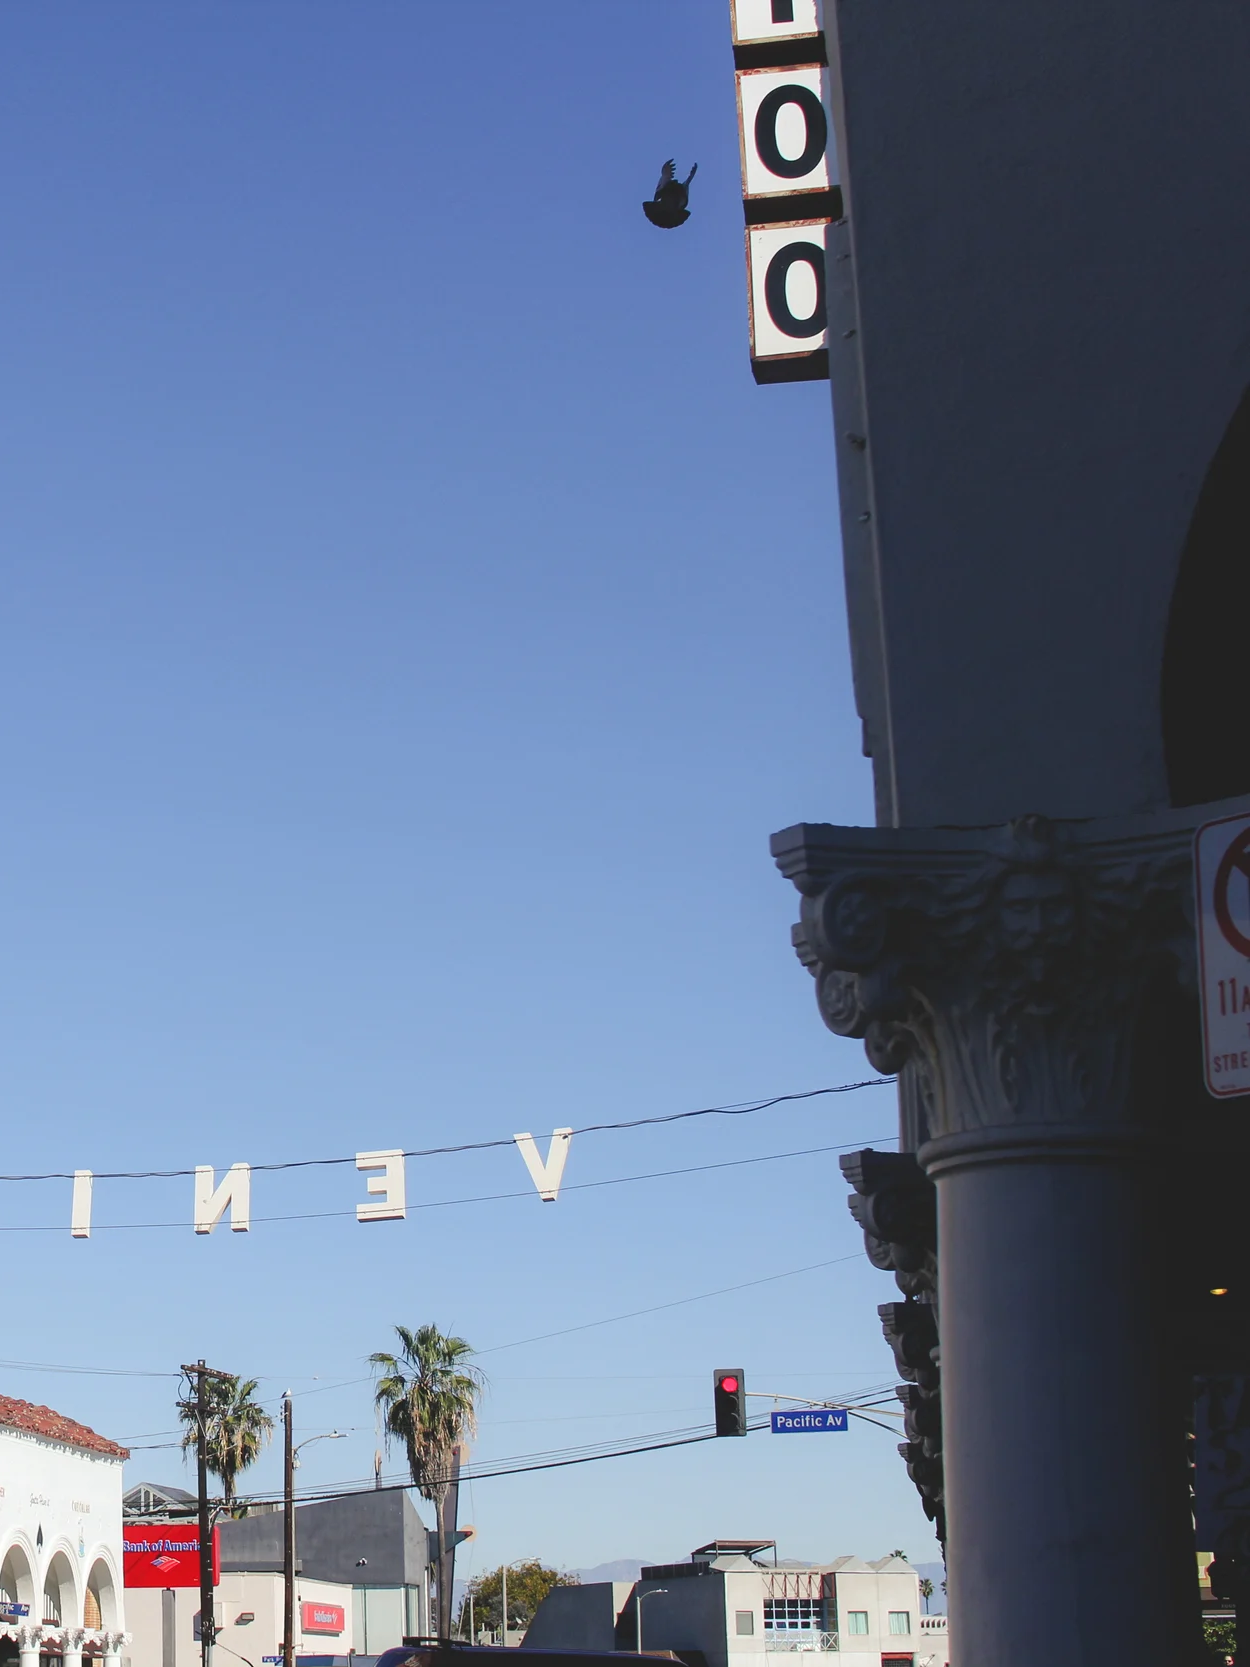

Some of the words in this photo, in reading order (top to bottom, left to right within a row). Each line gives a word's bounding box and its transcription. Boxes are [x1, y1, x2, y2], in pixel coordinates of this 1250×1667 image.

[754, 0, 828, 338] OO
[777, 1415, 822, 1428] Pacific
[826, 1414, 842, 1426] Av
[123, 1540, 151, 1552] Bank
[151, 1539, 163, 1552] of
[164, 1539, 200, 1552] Ameri
